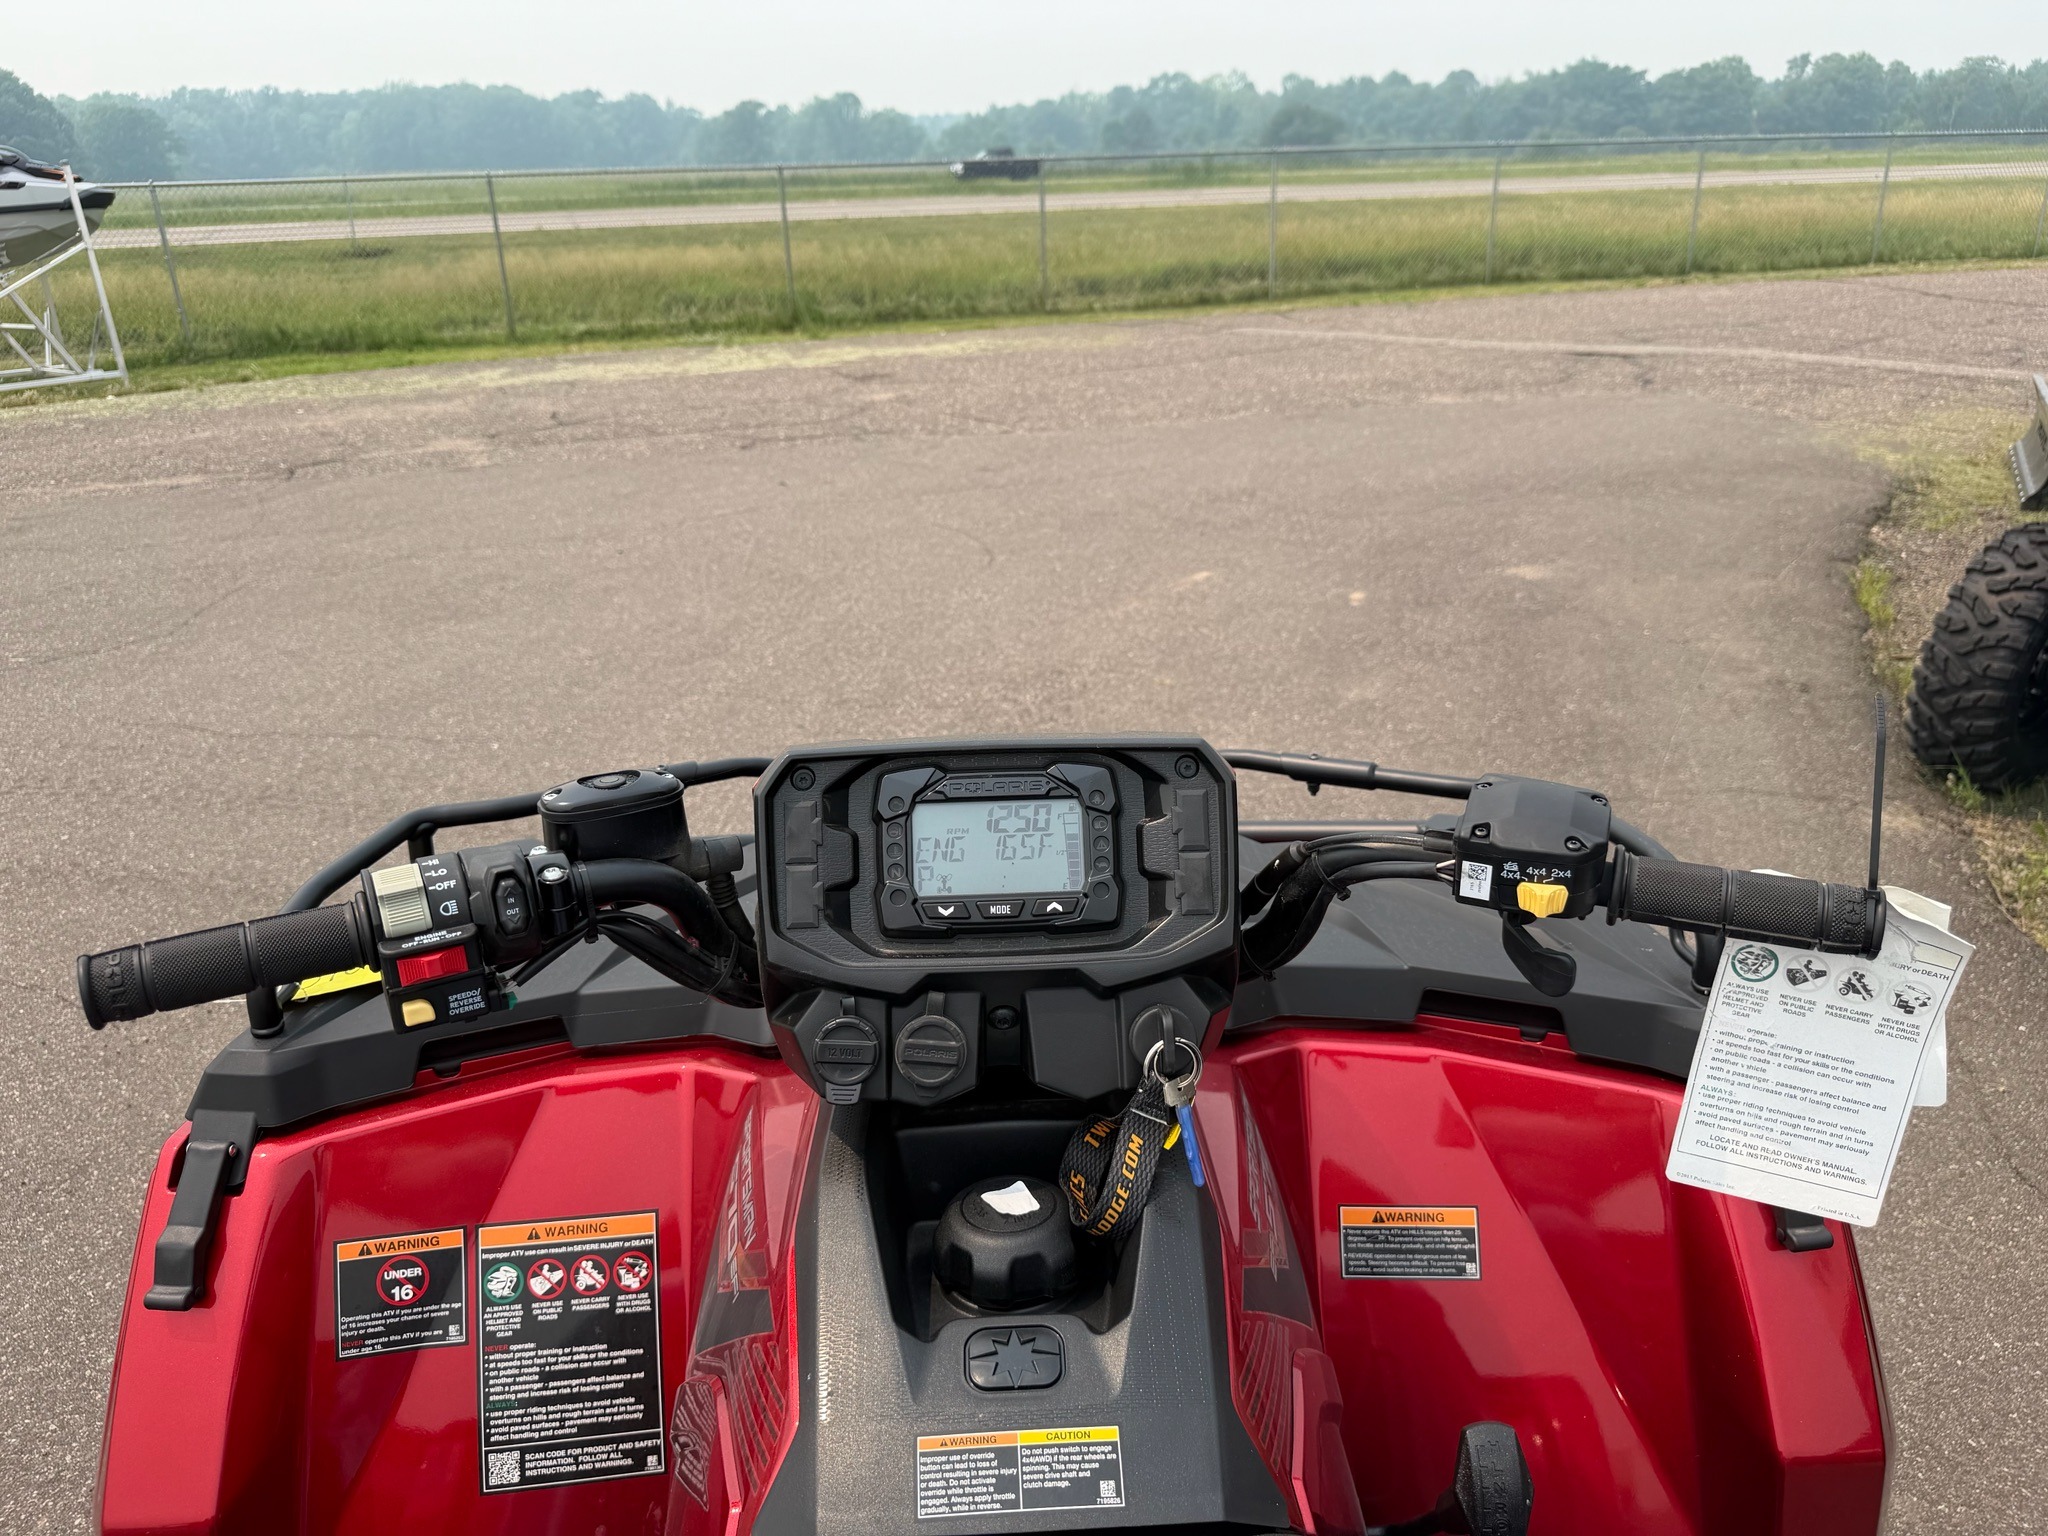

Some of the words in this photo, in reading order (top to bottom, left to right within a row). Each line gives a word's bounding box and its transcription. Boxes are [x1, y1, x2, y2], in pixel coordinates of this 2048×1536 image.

[949, 780, 1045, 794] POLARIS
[986, 803, 1052, 834] 1250
[915, 836, 966, 863] ENG
[918, 866, 934, 893] P
[1500, 870, 1521, 880] 4x4
[1526, 868, 1546, 876] 4x4
[1551, 869, 1571, 878] 2x4
[990, 905, 1011, 914] MODE
[414, 931, 447, 941] ENGINE
[1921, 968, 1950, 981] DEATH
[449, 988, 481, 1001] SPEEDO/
[1779, 993, 1803, 1004] NEVER
[1803, 998, 1817, 1006] USE
[449, 1002, 485, 1015] OVERRIDE
[450, 996, 482, 1008] REVERSE
[1790, 1002, 1815, 1013] PUBLIC
[1782, 1008, 1806, 1017] ROADS
[1824, 1010, 1871, 1025] PASSENGERS
[1826, 1003, 1849, 1014] NEVER
[1850, 1009, 1874, 1019] CARRY
[1877, 1022, 1894, 1031] WITH
[1895, 1027, 1921, 1037] DRUGS
[1881, 1016, 1904, 1027] NEVER
[1906, 1022, 1920, 1030] USE
[1886, 1031, 1919, 1044] ALCOHOL
[828, 1048, 837, 1058] 12
[840, 1049, 863, 1059] VOLT
[904, 1048, 958, 1059] POLARIS
[1725, 1040, 1751, 1052] speeds
[1753, 1046, 1766, 1054] too
[1767, 1049, 1781, 1058] fast
[1782, 1053, 1793, 1061] for
[1794, 1057, 1811, 1066] your
[1812, 1060, 1830, 1070] skills
[1840, 1066, 1853, 1075] the
[1854, 1069, 1895, 1085] conditions
[1709, 1134, 1740, 1147] LOCATE
[1742, 1142, 1759, 1152] AND
[1784, 1152, 1821, 1166] OWNER'S
[1822, 1161, 1857, 1175] MANUAL.
[1695, 1139, 1728, 1153] FOLLOW
[1729, 1147, 1744, 1157] ALL
[1746, 1151, 1803, 1170] INSTRUCTIONS
[1804, 1165, 1822, 1175] AND
[1823, 1170, 1868, 1186] WARNINGS.
[1385, 1212, 1444, 1222] WARNING
[545, 1222, 608, 1237] WARNING
[374, 1236, 440, 1253] WARNING
[482, 1251, 510, 1260] Improper
[549, 1245, 566, 1253] result
[574, 1243, 600, 1251] SEVERE
[600, 1241, 624, 1250] INJURY
[632, 1238, 654, 1247] DEATH
[384, 1267, 422, 1280] UNDER
[391, 1285, 414, 1301] 16
[341, 1314, 370, 1323] Operating
[401, 1308, 412, 1316] you
[365, 1337, 388, 1345] operate
[421, 1330, 432, 1338] you
[504, 1408, 526, 1417] proper
[527, 1405, 546, 1414] riding
[548, 1402, 584, 1413] techniques
[593, 1398, 610, 1407] avoid
[612, 1396, 635, 1404] vehicle
[950, 1436, 996, 1446] WARNING
[1046, 1431, 1091, 1441] CAUTION
[525, 1452, 545, 1460] SCAN
[546, 1450, 566, 1458] CODE
[584, 1444, 617, 1454] PRODUCT
[619, 1442, 633, 1450] AND
[635, 1439, 661, 1448] SAFETY
[1044, 1447, 1059, 1456] push
[525, 1457, 575, 1468] INFORMATION.
[579, 1453, 608, 1462] FOLLOW
[609, 1451, 623, 1459] ALL
[920, 1455, 948, 1463] Improper
[525, 1464, 577, 1476] INSTRUCTIONS
[578, 1462, 593, 1470] AND
[595, 1457, 634, 1468] WARNINGS.
